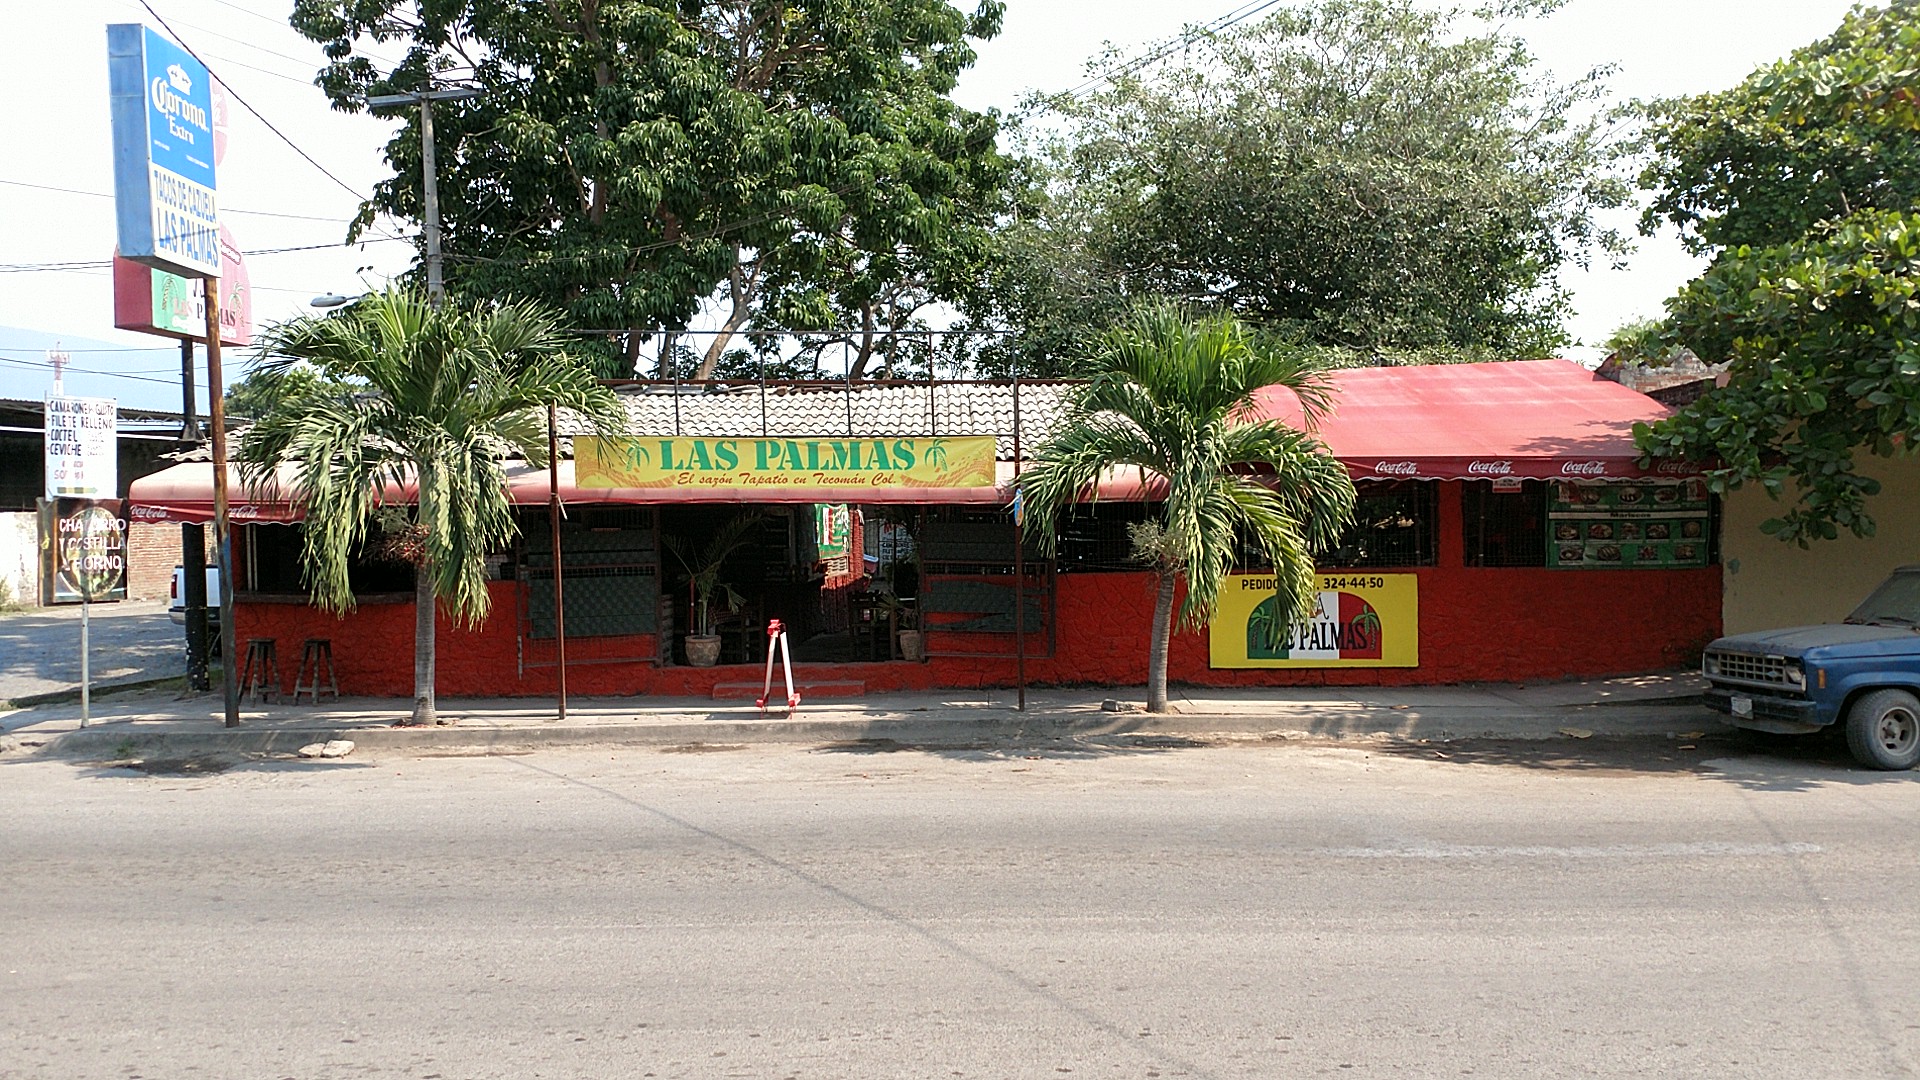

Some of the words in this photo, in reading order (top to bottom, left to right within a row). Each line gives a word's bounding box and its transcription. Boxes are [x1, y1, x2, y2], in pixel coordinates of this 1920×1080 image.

[151, 76, 207, 132] Corona
[169, 115, 195, 145] Extra
[154, 169, 177, 208] TACOS
[178, 180, 187, 212] DE
[188, 185, 217, 224] CAZUELA
[157, 207, 178, 254] LAS
[180, 216, 219, 268] PALMAS
[51, 415, 77, 428] FILETE
[80, 416, 113, 430] RELLENO
[51, 428, 78, 443] COCTEL
[50, 443, 82, 457] CEVICHE
[658, 440, 739, 471] LAS
[754, 440, 916, 471] PALMAS
[677, 472, 695, 485] El
[699, 473, 733, 488] sazón
[793, 476, 807, 484] en
[813, 472, 866, 485] Tecomán
[871, 472, 897, 486] Col.
[1299, 622, 1368, 651] PALMAS
